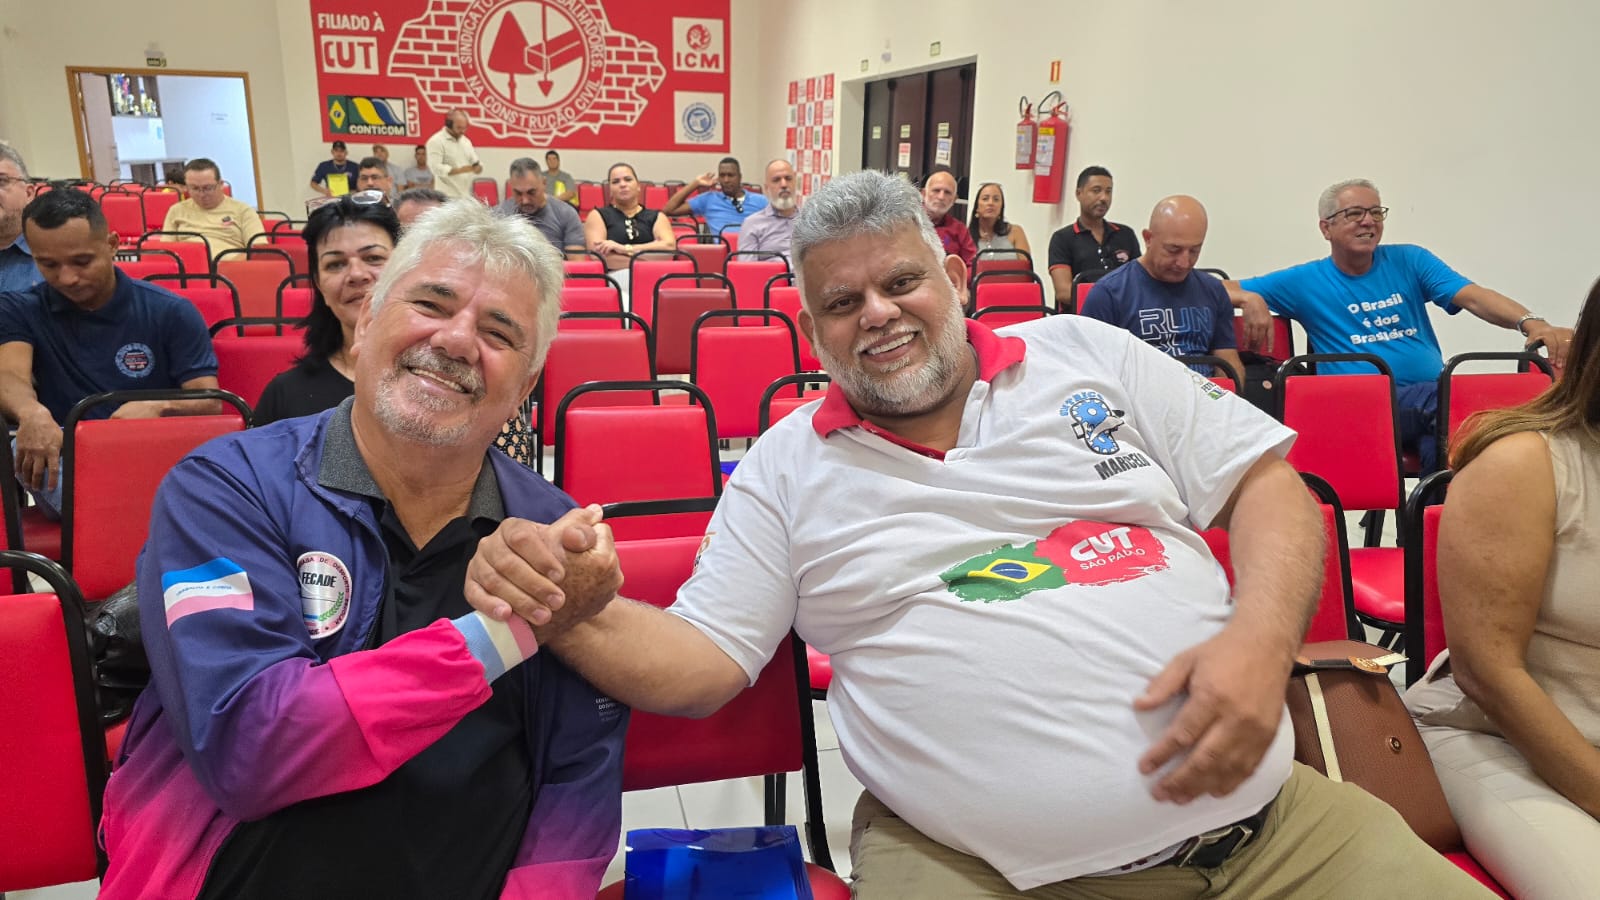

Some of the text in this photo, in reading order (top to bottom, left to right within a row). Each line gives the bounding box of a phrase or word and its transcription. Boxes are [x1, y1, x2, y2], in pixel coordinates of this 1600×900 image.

[317, 11, 385, 32] FILIADO À
[558, 0, 603, 67] ALHADORES
[323, 41, 374, 69] CUT
[676, 51, 720, 69] ICM
[466, 75, 601, 130] NA CONSTRUÇÃO CIVIL
[349, 124, 405, 136] CONTICOM
[1348, 293, 1403, 314] O Brasil
[1138, 306, 1212, 335] RUN
[1373, 314, 1400, 327] dos
[1071, 527, 1133, 562] CUT
[1079, 558, 1107, 571] SÃO
[302, 571, 338, 588] FECADE
